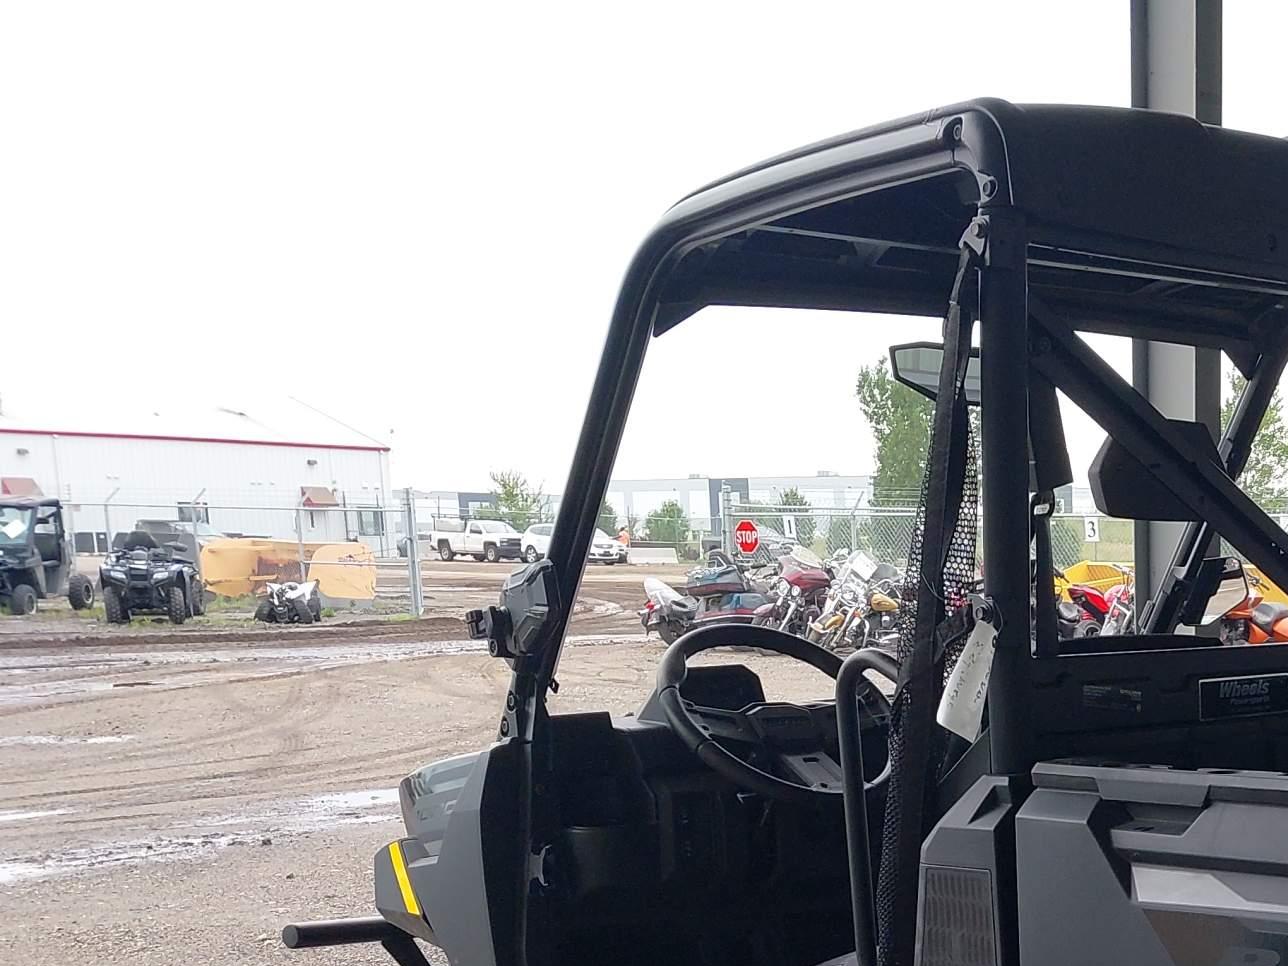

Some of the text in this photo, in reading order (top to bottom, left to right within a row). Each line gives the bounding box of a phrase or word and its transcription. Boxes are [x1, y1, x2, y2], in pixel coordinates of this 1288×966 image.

[736, 530, 757, 544] STOP
[1087, 521, 1096, 538] 3
[1219, 679, 1270, 698] Wheels
